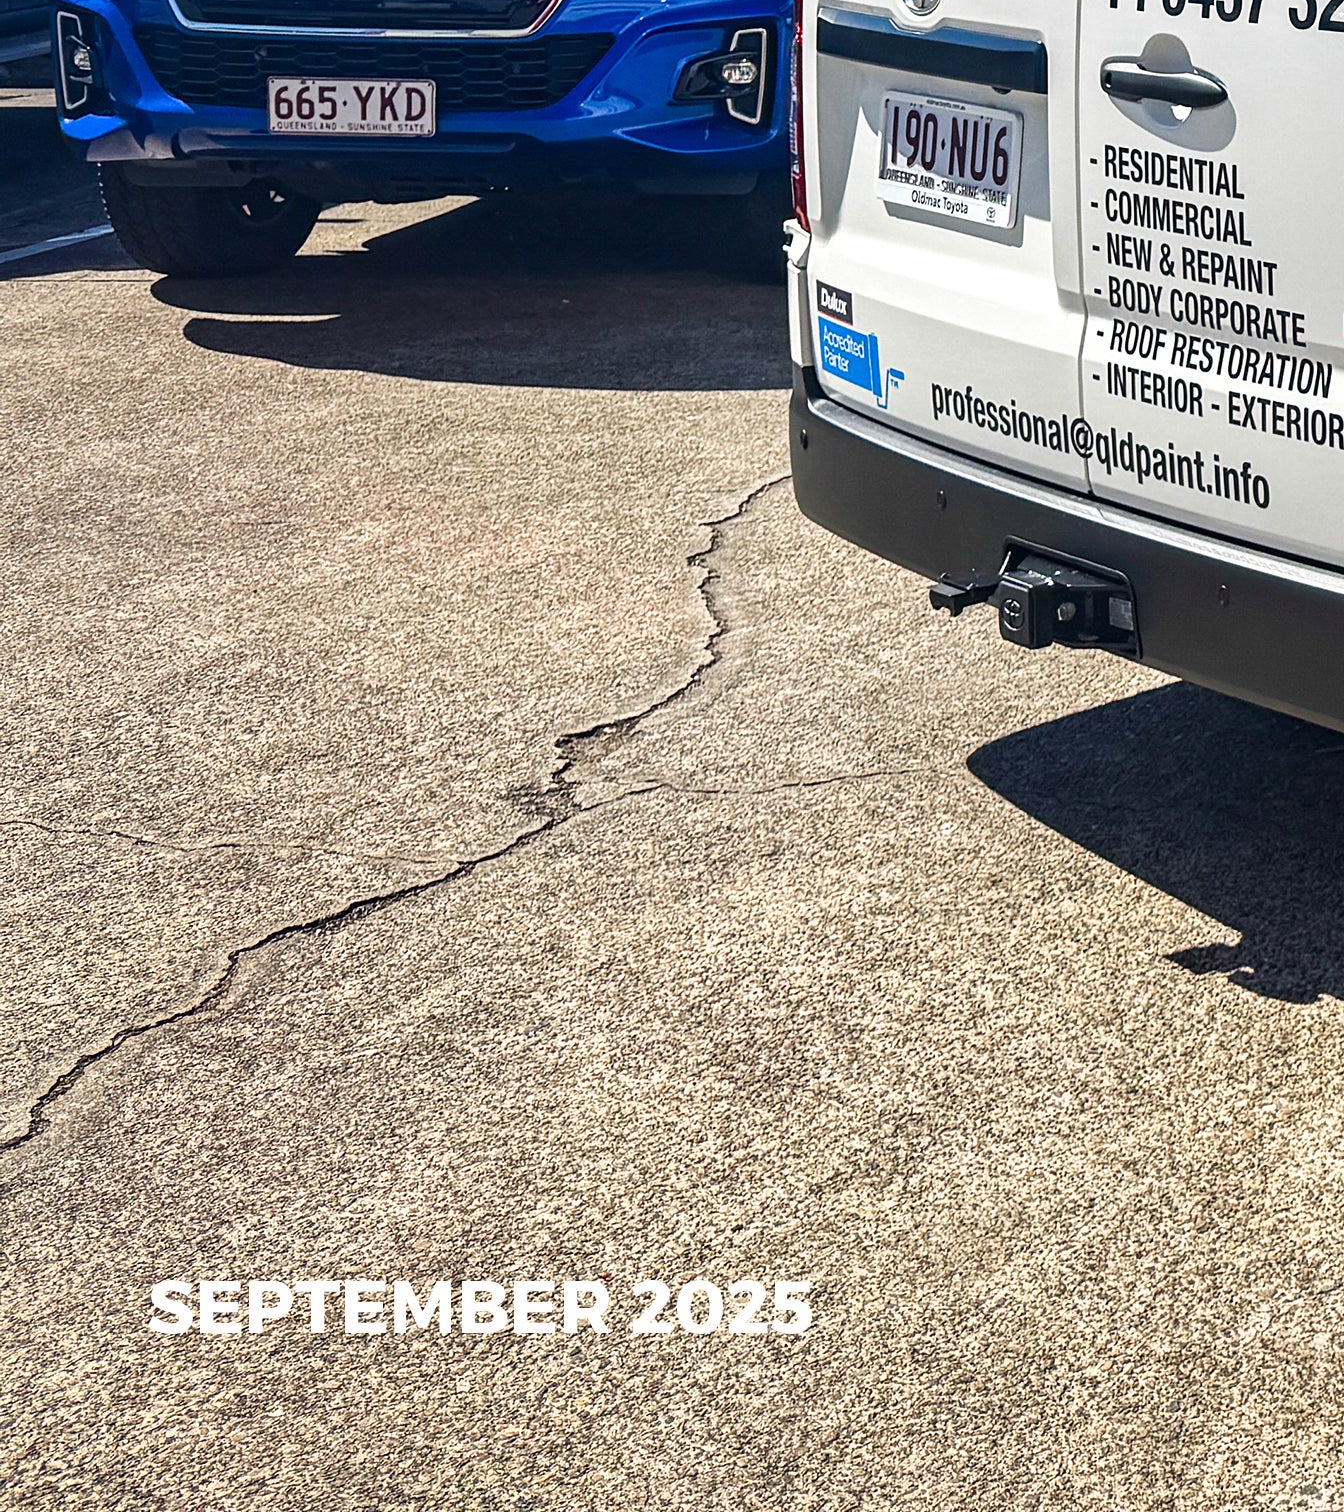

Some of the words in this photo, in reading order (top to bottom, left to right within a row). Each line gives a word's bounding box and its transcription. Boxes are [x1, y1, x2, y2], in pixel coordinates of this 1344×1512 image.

[277, 121, 337, 131] QUEENSLAND
[348, 122, 392, 132] SUNSHINE
[398, 123, 425, 132] STATE
[1104, 144, 1245, 200] RESIDENTIAL
[911, 190, 941, 209] Oldmac
[943, 196, 968, 214] Toyota
[1105, 188, 1252, 247] COMMERCIAL
[1106, 232, 1152, 272] NEW
[1159, 243, 1175, 277] &
[1181, 246, 1278, 296] REPAINT
[821, 287, 847, 315] Dulux
[1109, 275, 1163, 317] BODY
[1170, 288, 1307, 347] CORPORATE
[823, 325, 865, 359] Accredited
[824, 345, 849, 372] Painter
[1110, 318, 1167, 361] ROOF
[1171, 332, 1332, 399] RESTORATION
[1107, 362, 1203, 417] INTERIOR
[1228, 391, 1344, 450] EXTERIOR
[931, 382, 1271, 510] professional@qldpaint.info
